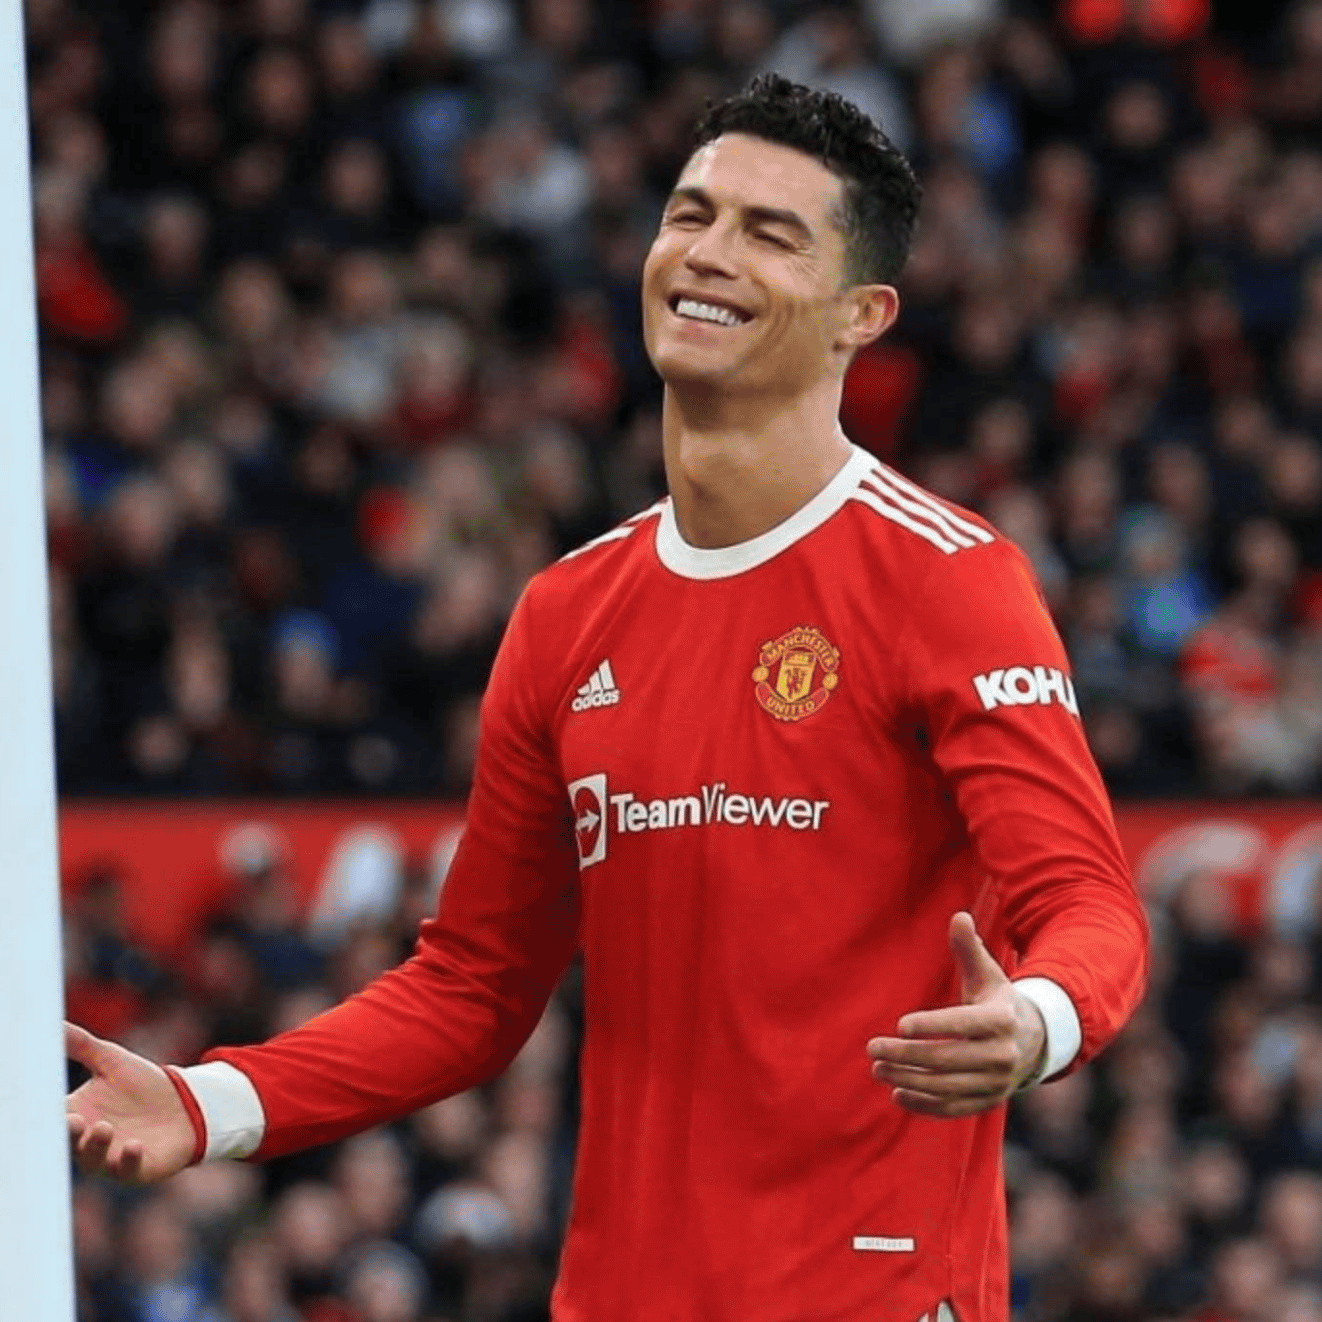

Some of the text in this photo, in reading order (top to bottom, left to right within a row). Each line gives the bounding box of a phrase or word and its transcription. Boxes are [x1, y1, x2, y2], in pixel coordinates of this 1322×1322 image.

[764, 634, 836, 668] MANCHESTER
[571, 688, 620, 712] adidas
[766, 696, 816, 715] UNITED
[609, 782, 831, 834] TeamViewer
